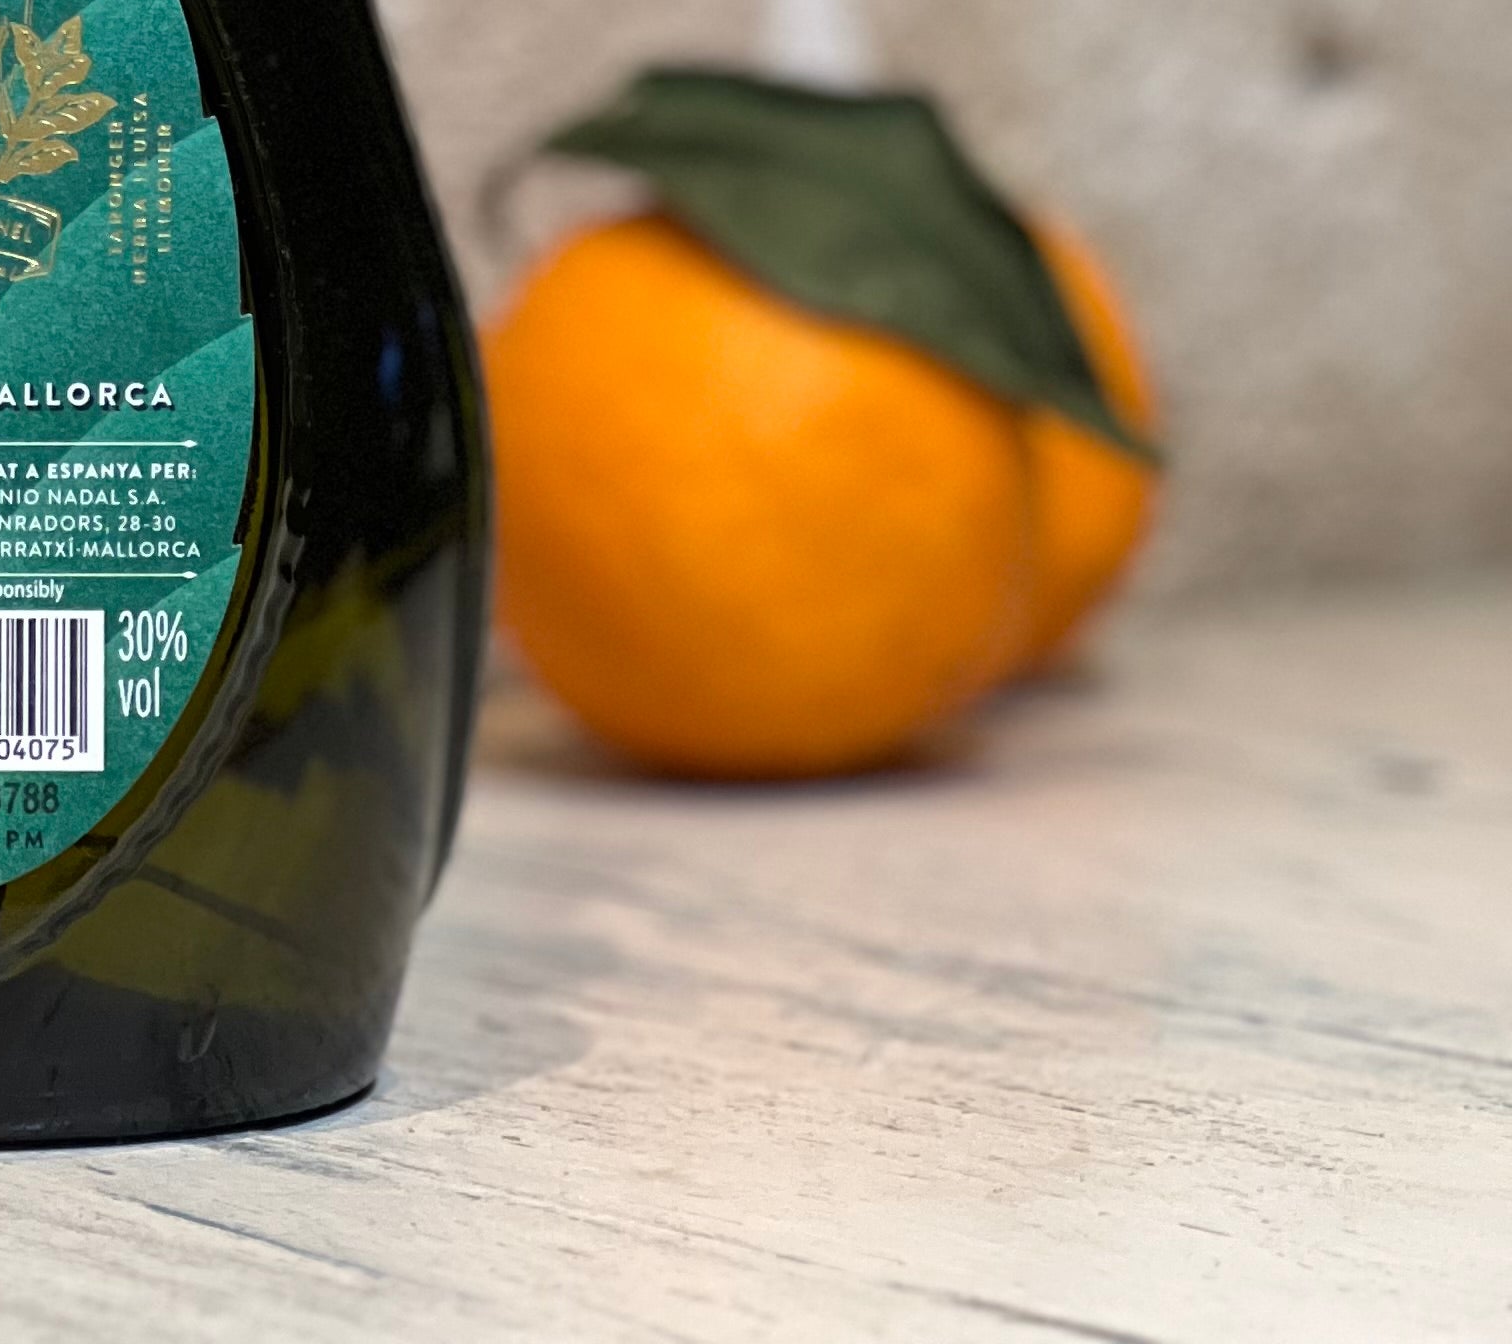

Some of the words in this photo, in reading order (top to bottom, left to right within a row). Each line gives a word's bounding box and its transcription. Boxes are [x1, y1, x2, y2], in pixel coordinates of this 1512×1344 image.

[109, 121, 124, 255] TARONGER
[133, 198, 148, 285] HERBA
[25, 463, 40, 479] A
[47, 463, 143, 479] ESPANYA
[150, 463, 197, 479] PER:
[48, 489, 120, 505] NADAL
[127, 489, 167, 505] S.A.
[118, 515, 176, 532] 28-30
[118, 610, 188, 662] 30%
[118, 666, 160, 718] vol
